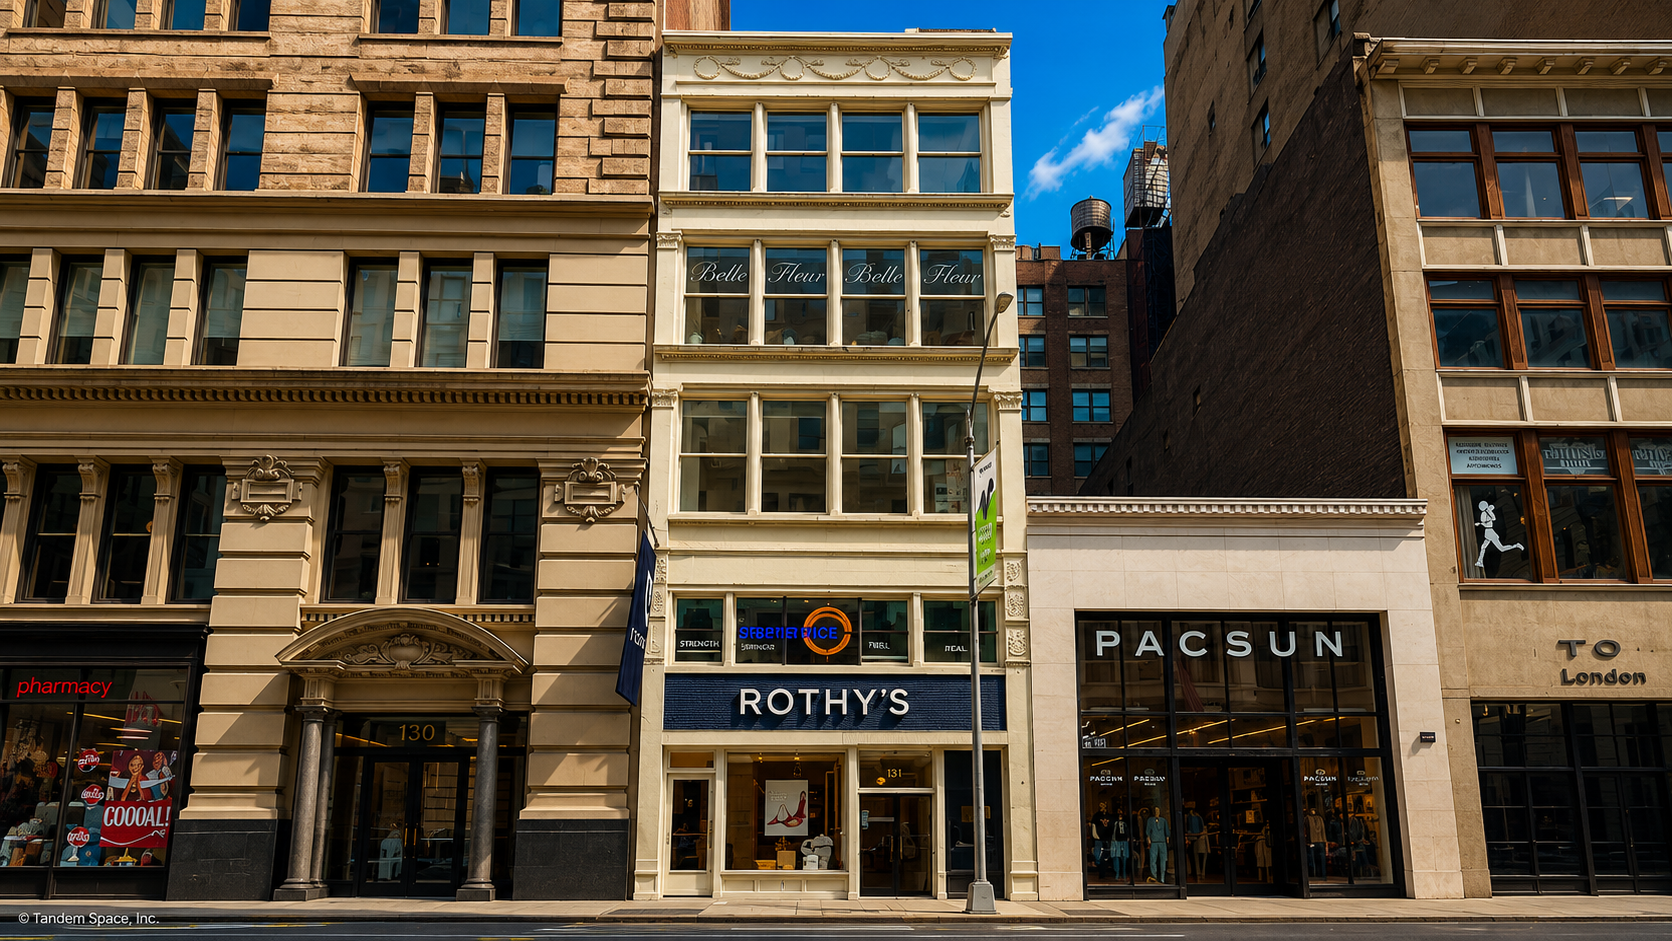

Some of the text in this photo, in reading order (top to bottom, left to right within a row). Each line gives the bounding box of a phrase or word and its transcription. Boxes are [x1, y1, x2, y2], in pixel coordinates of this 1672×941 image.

[690, 261, 981, 284] Belle Fleur Belle Fleur
[1096, 631, 1343, 657] PACSUN
[1557, 639, 1622, 660] TO
[16, 677, 113, 698] pharmacy
[1561, 668, 1646, 686] London
[740, 688, 910, 715] ROTHY'S
[399, 724, 435, 741] 130
[887, 768, 902, 778] 131
[103, 806, 171, 827] COOOAL!
